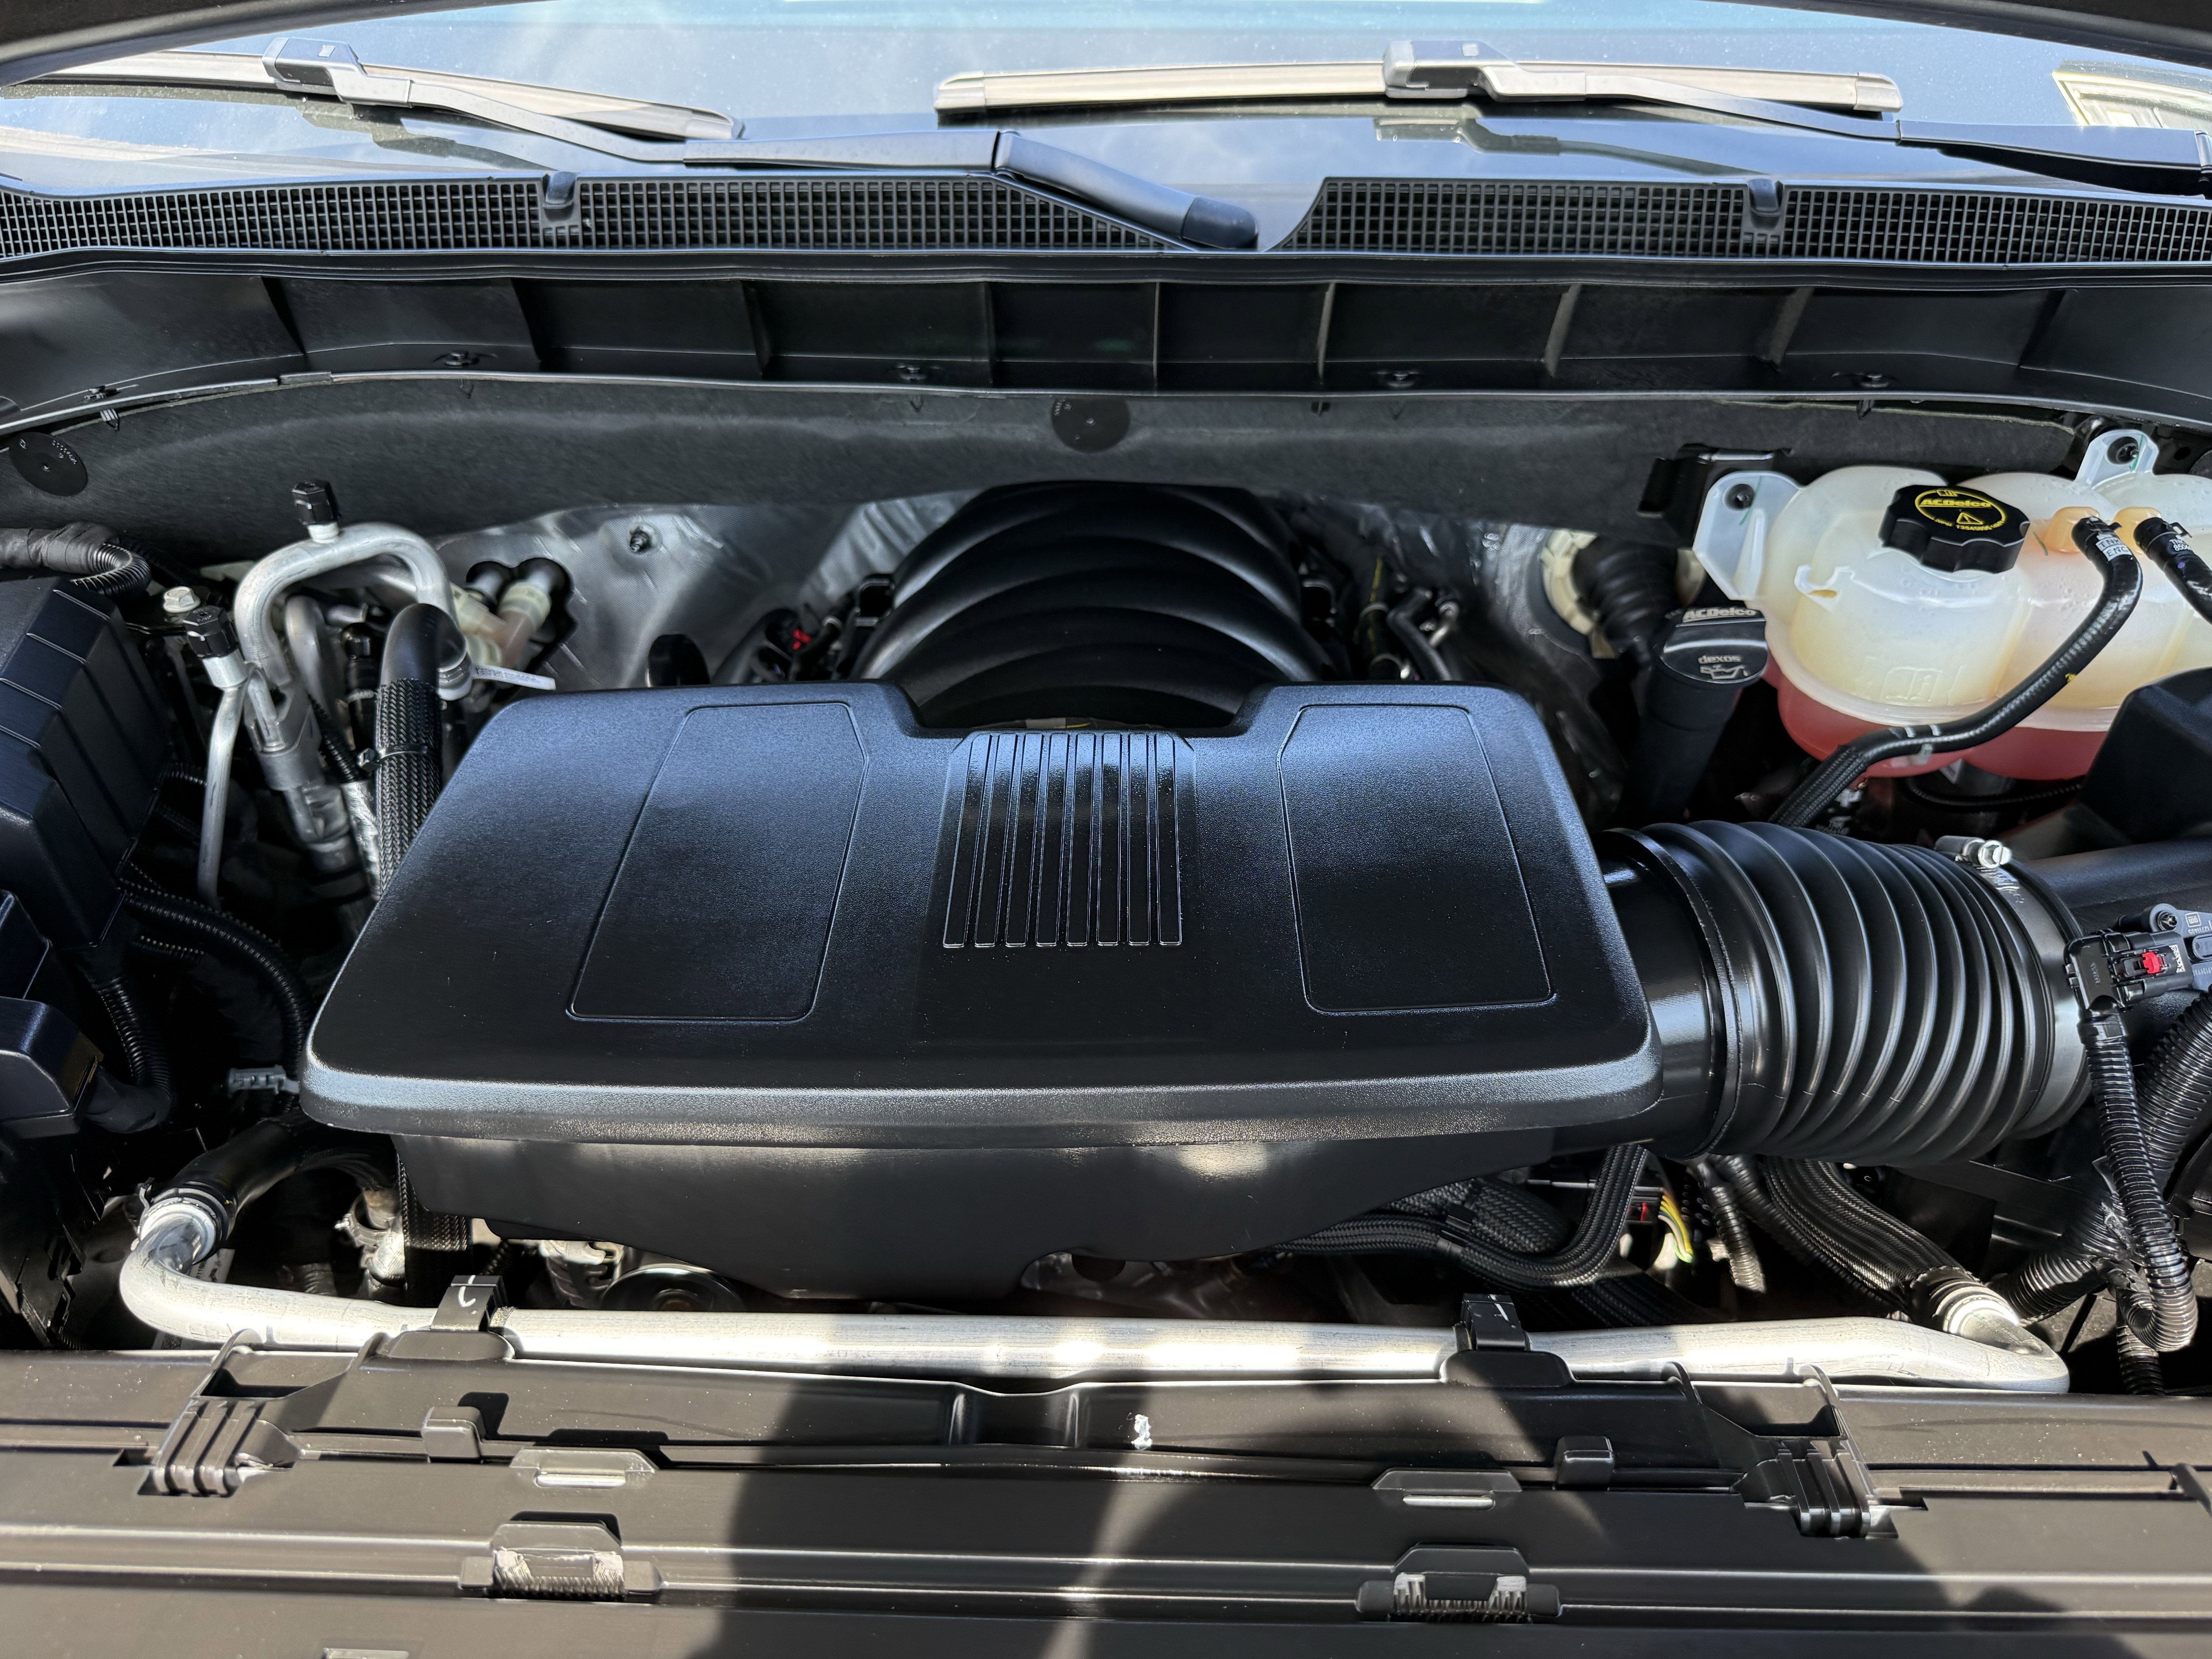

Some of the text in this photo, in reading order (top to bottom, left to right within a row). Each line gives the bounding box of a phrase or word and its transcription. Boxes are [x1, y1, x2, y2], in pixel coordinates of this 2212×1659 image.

[1919, 499, 1992, 508] ACDelco
[2107, 546, 2128, 557] ENG
[1683, 607, 1757, 623] ACDelco
[1698, 656, 1741, 664] dexos
